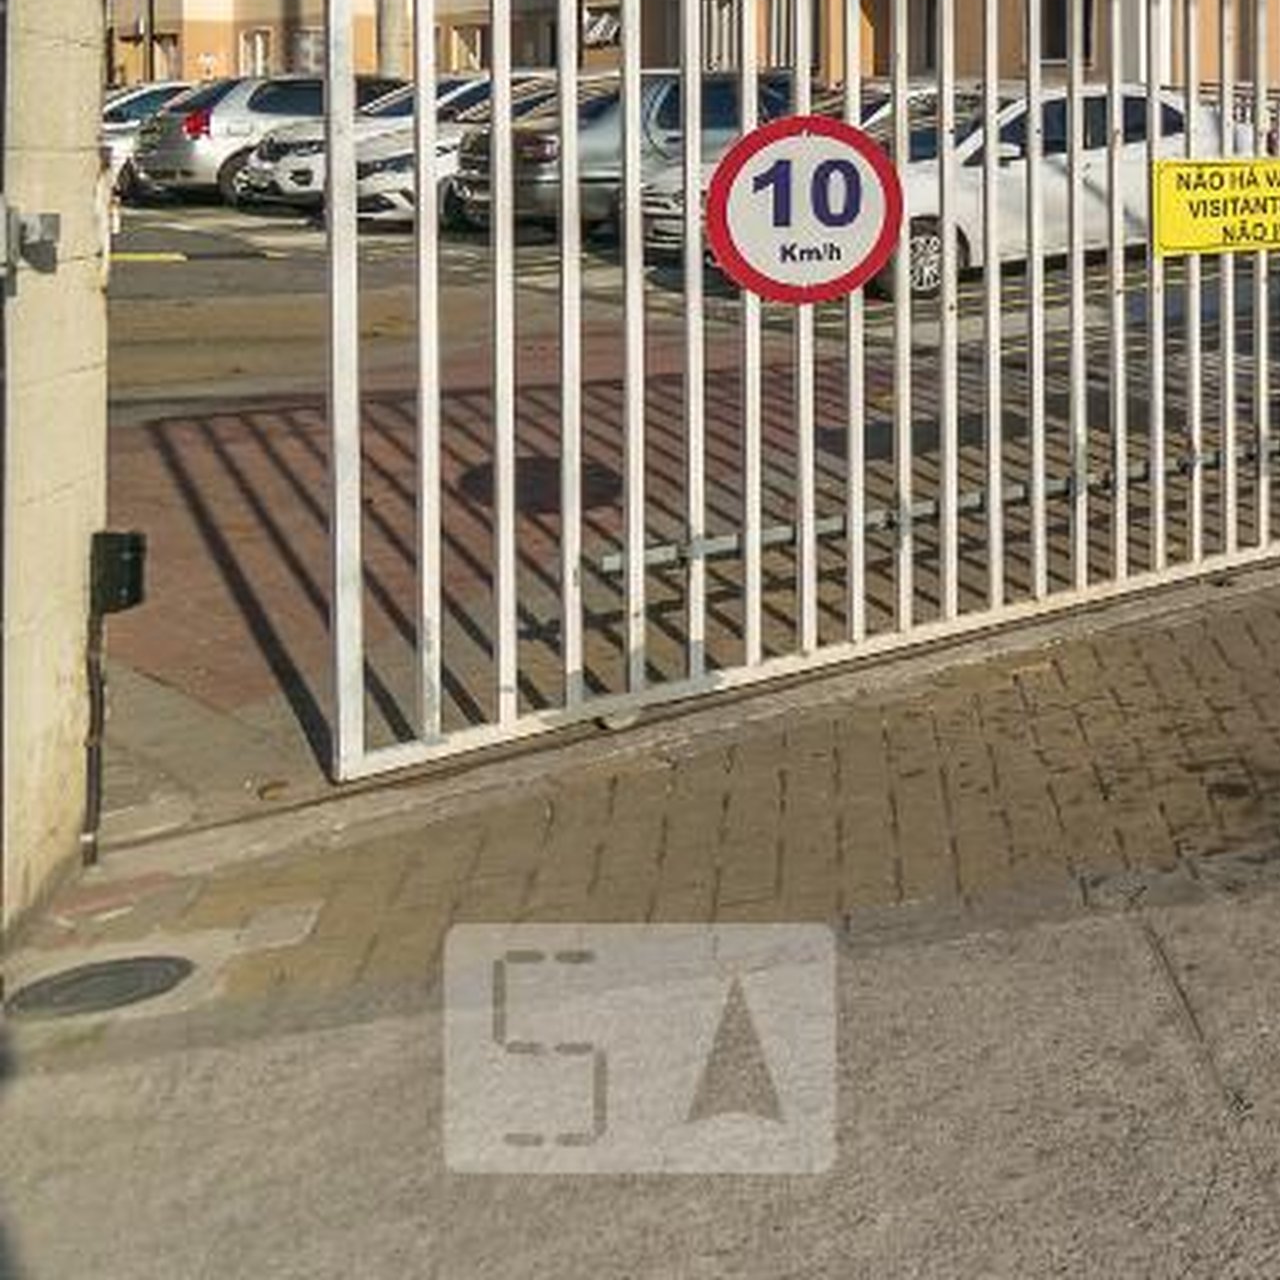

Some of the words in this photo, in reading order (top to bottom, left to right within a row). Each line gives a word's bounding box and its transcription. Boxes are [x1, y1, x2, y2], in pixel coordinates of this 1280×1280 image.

[1176, 170, 1225, 191] NÃO
[1230, 170, 1258, 189] HÁ
[752, 159, 862, 227] 10
[1222, 221, 1266, 242] NÃO
[780, 243, 842, 263] Km/h
